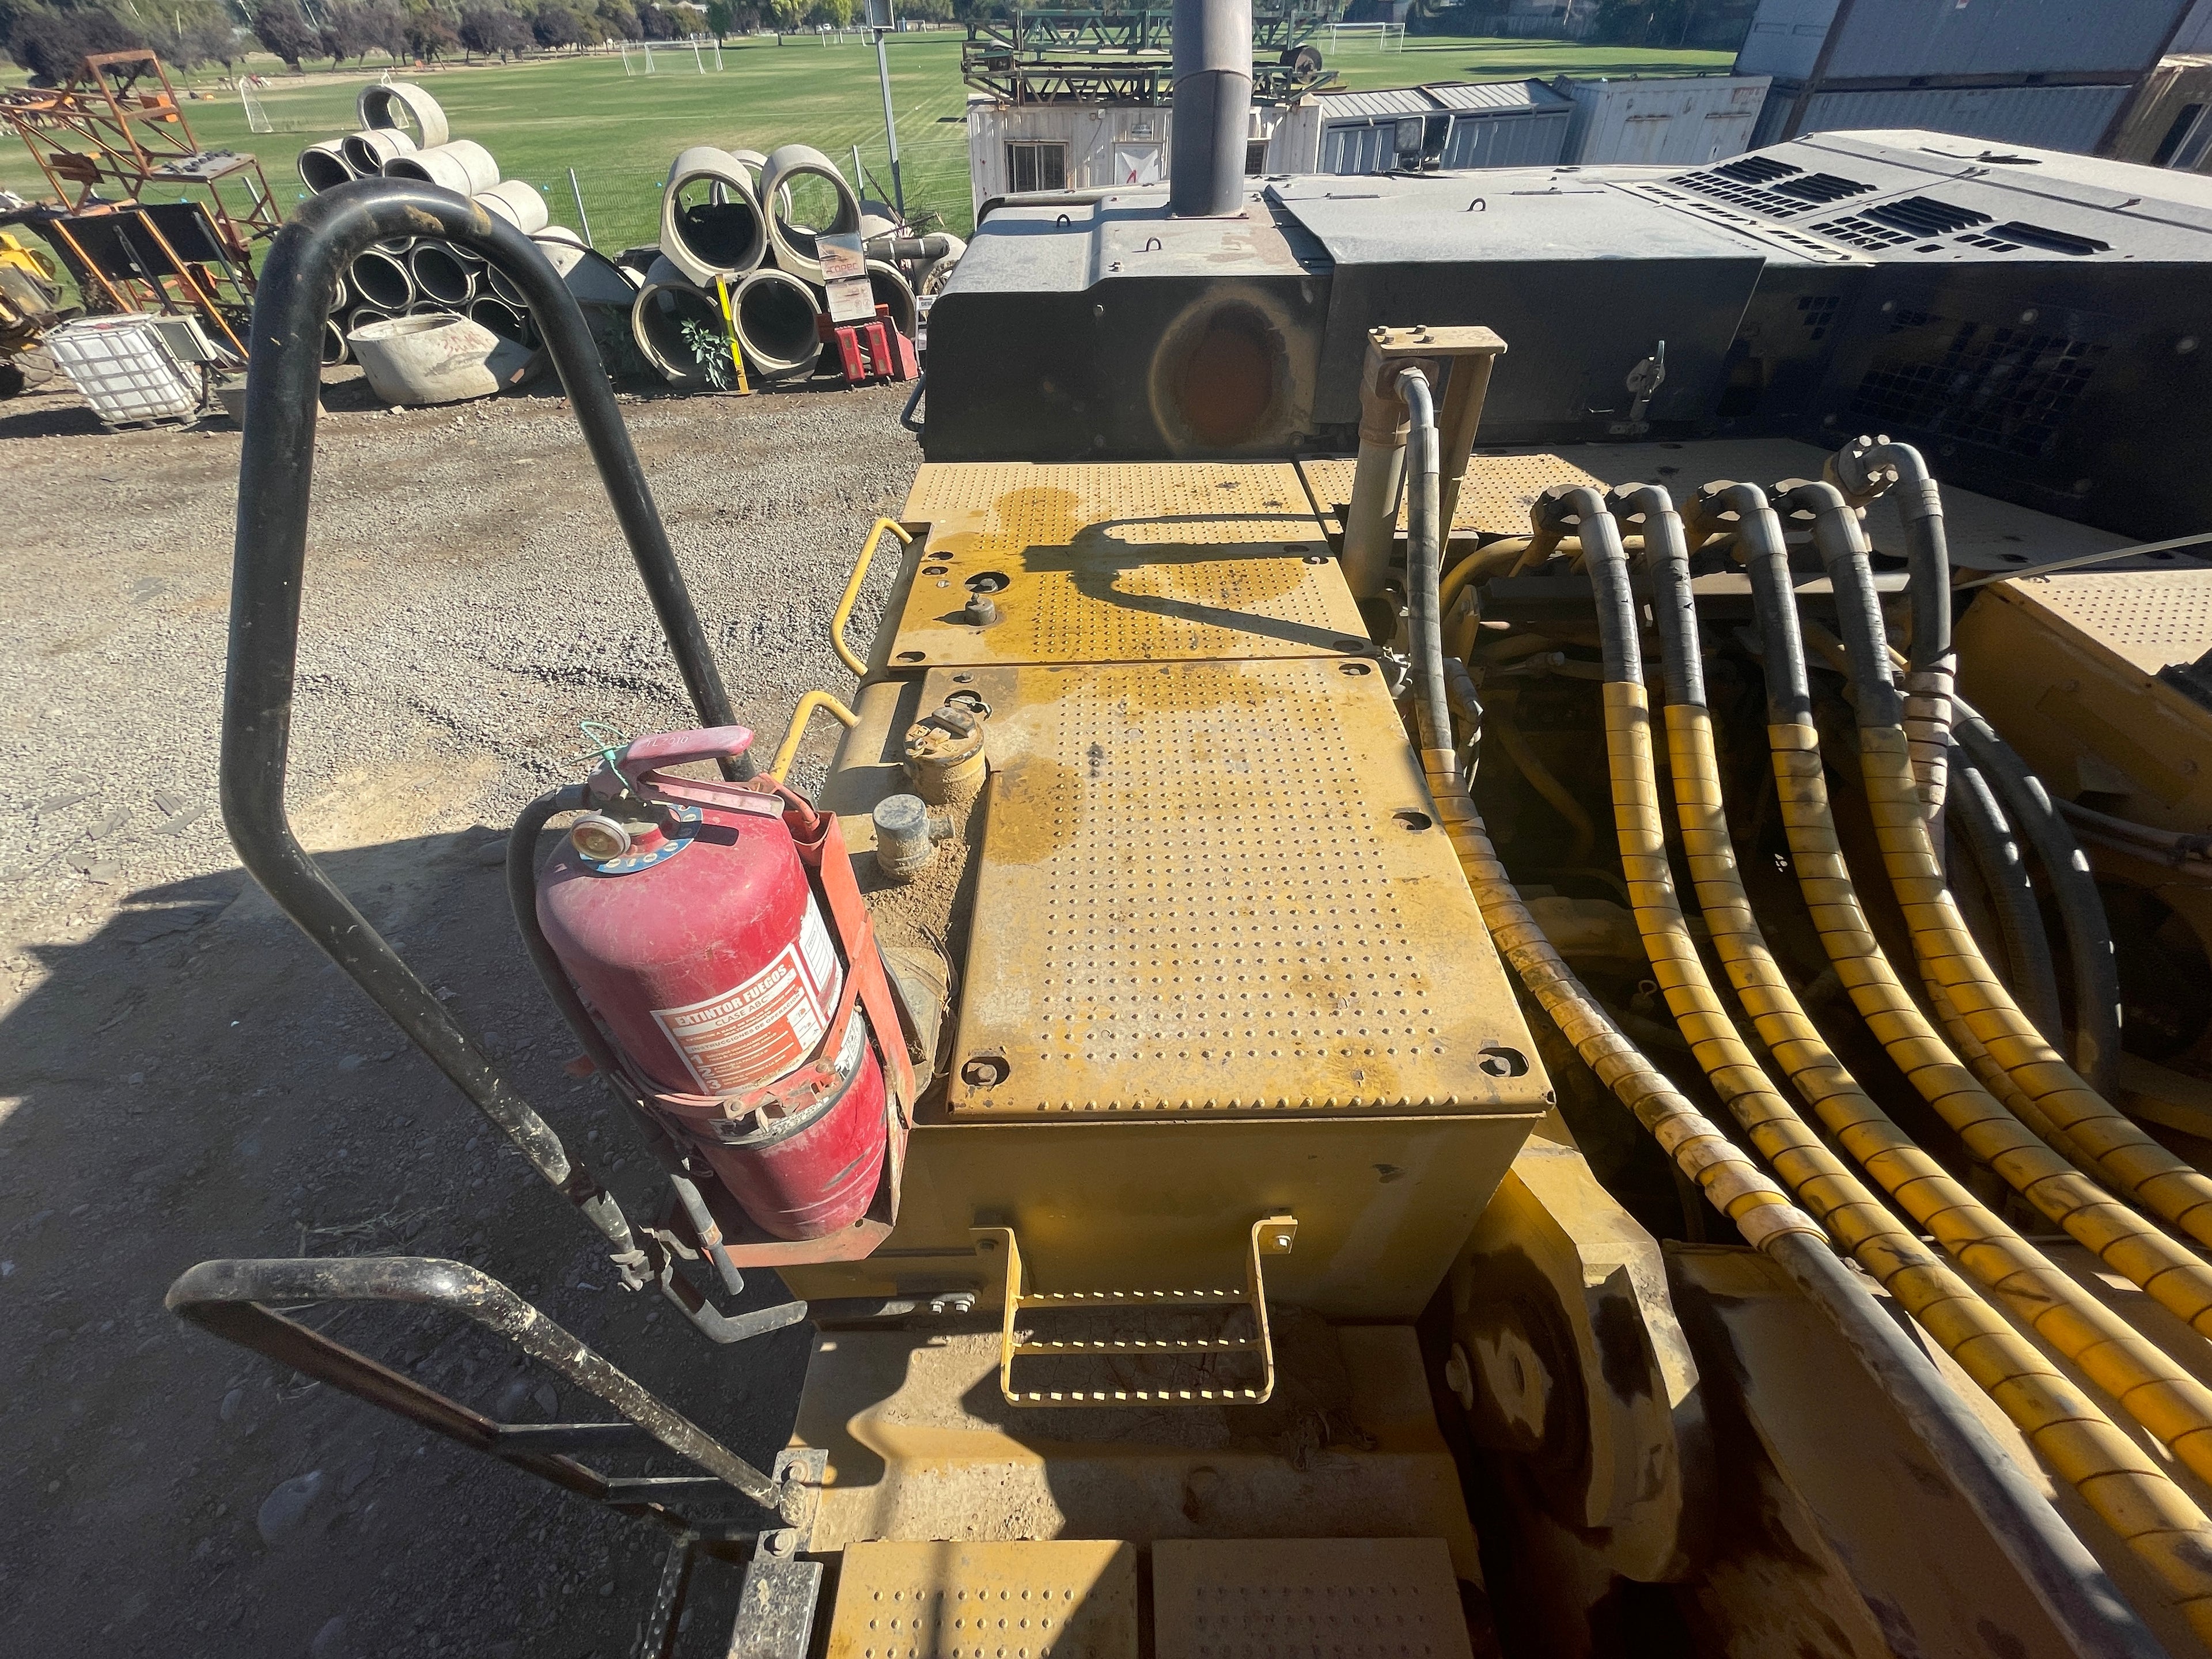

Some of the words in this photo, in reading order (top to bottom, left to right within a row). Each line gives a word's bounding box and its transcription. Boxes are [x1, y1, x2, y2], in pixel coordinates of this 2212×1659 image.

[675, 997, 743, 1026] EXTINTOR
[743, 964, 787, 1003] FUEGOS
[715, 1009, 746, 1026] CLASE
[749, 994, 770, 1012] ABC
[692, 1029, 754, 1051] INSTRUCCIONES
[766, 993, 800, 1024] OPERACION
[691, 1054, 703, 1064] 1
[698, 1068, 714, 1077] 2
[706, 1080, 721, 1089] 3
